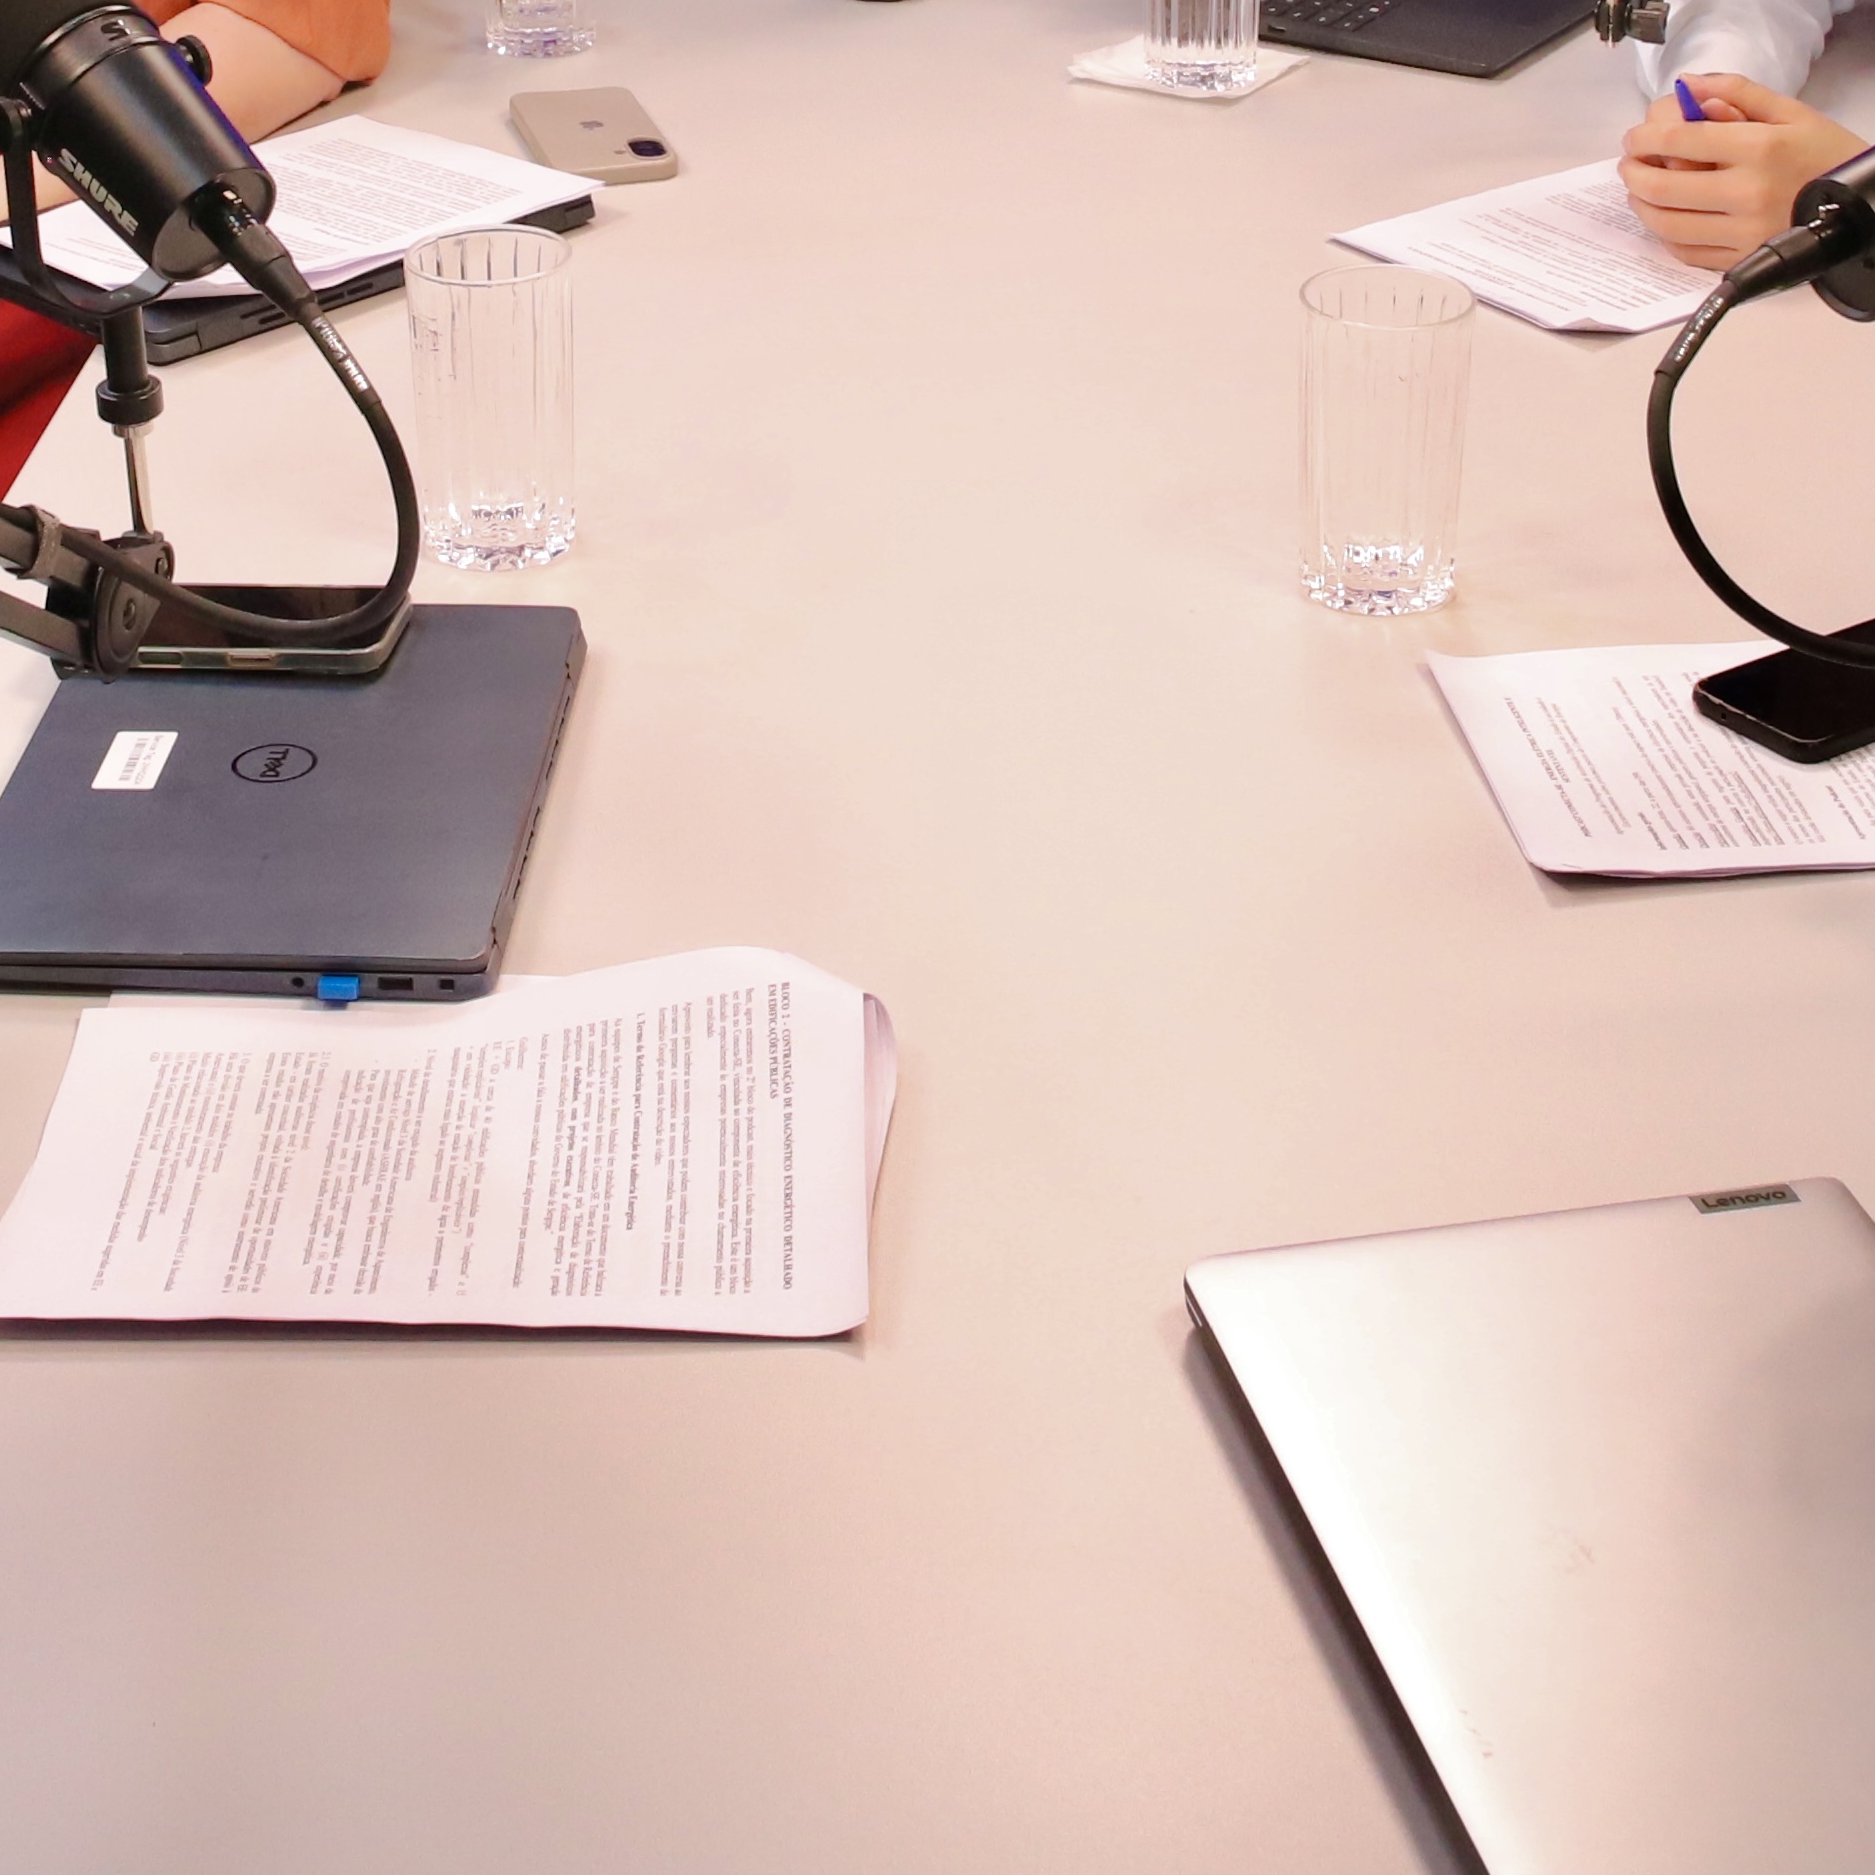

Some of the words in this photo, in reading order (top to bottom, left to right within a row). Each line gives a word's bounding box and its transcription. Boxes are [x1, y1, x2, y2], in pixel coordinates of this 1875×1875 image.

[58, 148, 139, 237] SHURE
[259, 748, 290, 778] DELL
[1700, 1191, 1787, 1208] Lenovo
